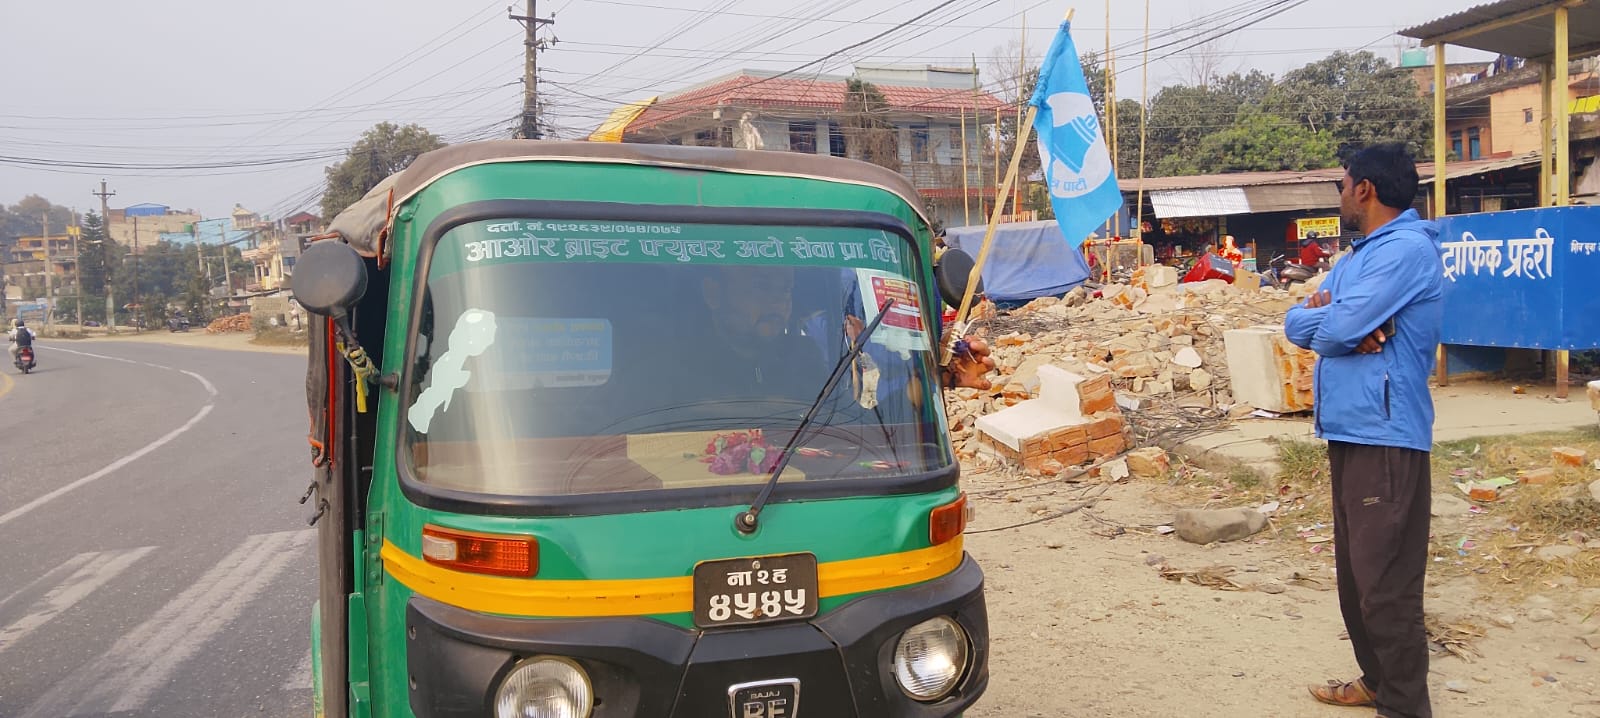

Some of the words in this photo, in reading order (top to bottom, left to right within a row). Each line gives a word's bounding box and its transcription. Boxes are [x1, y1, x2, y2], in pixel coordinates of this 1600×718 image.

[563, 238, 630, 259] ब्राइट
[733, 236, 785, 258] अटो
[789, 236, 835, 259] सेवा
[1440, 231, 1503, 282] ट्राफिक
[1503, 228, 1554, 280] प्रहरी
[727, 571, 752, 586] ना
[757, 570, 769, 584] २
[772, 568, 788, 583] ह
[708, 588, 806, 621] ४५४५
[751, 690, 780, 699] BAJAJ
